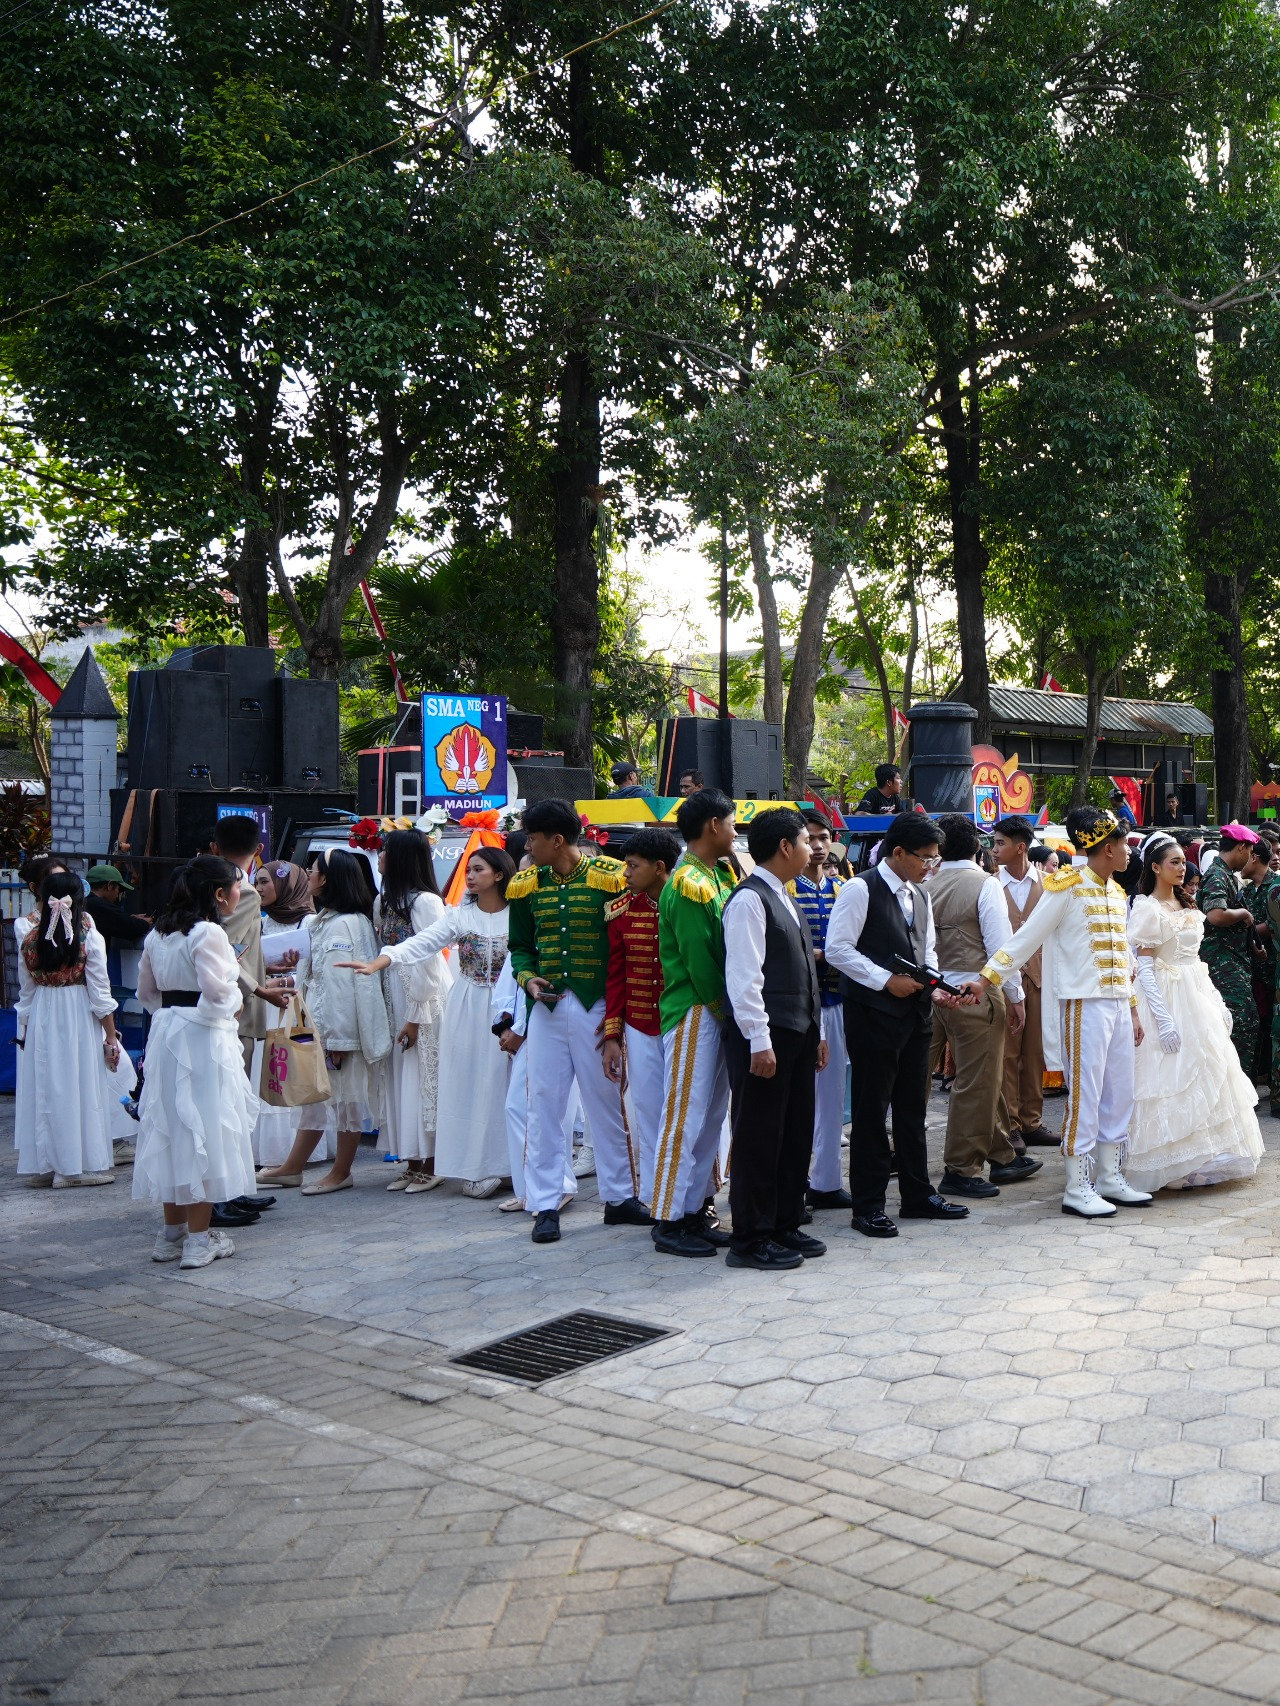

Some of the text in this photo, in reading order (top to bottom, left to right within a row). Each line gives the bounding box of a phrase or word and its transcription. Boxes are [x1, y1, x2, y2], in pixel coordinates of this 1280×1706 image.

[426, 697, 503, 722] SMA NEG 1
[444, 799, 492, 809] MADIUN
